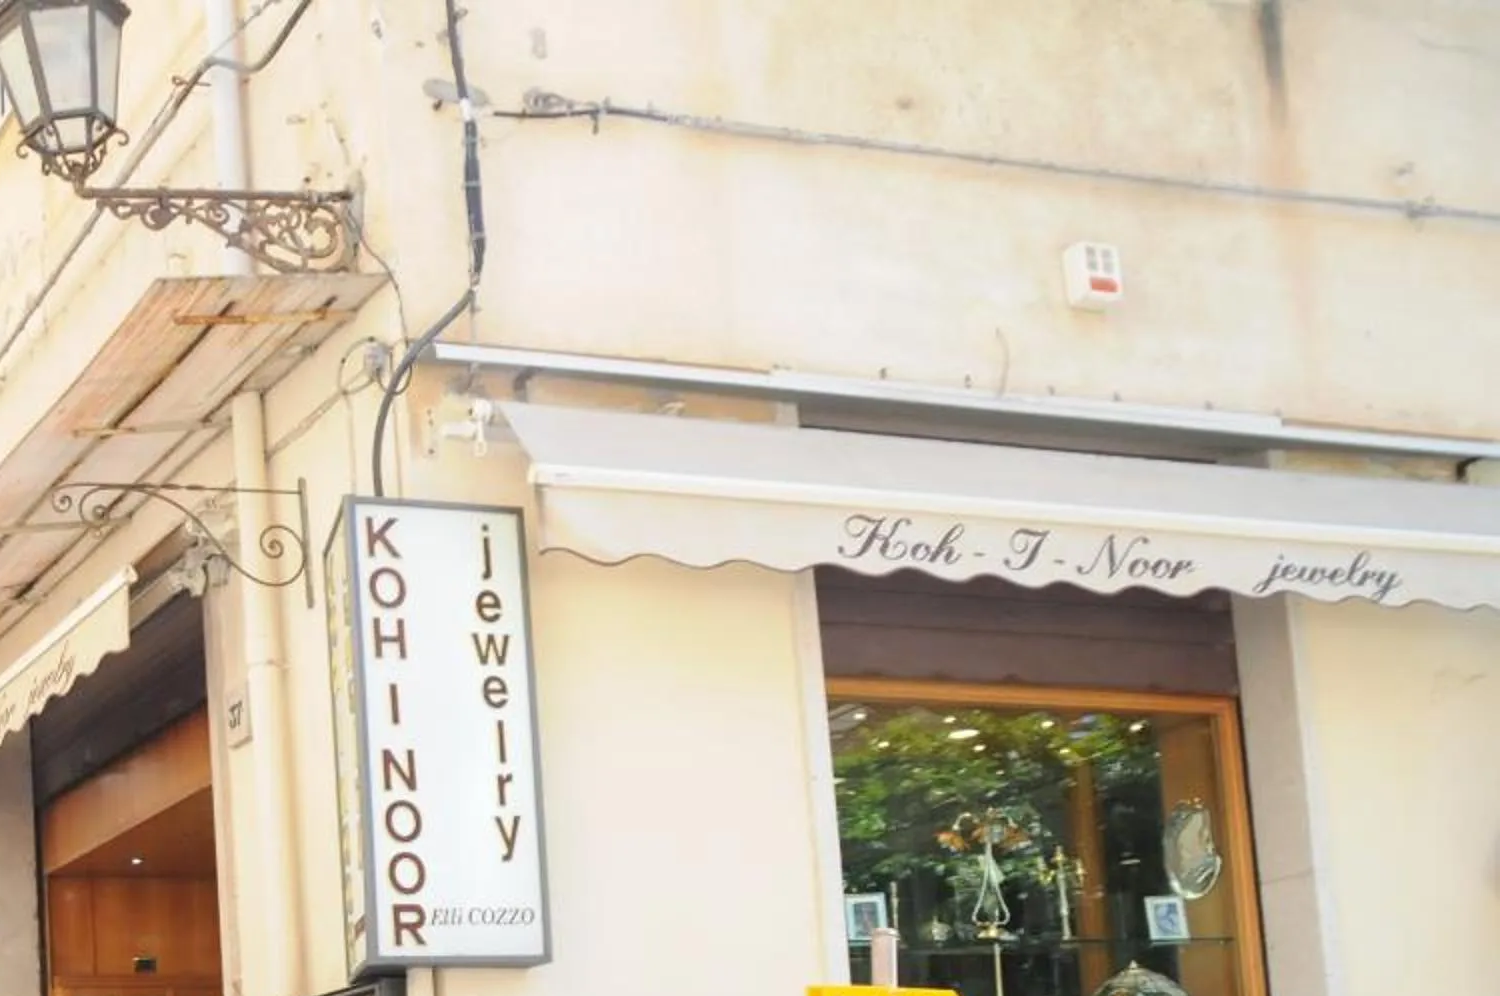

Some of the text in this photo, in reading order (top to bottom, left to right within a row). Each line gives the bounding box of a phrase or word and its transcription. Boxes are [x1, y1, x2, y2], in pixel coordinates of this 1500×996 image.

[837, 513, 965, 565] Koh
[1076, 533, 1197, 579] Noor
[1252, 550, 1403, 599] jewelry
[364, 516, 428, 947] KOH I NOOR
[471, 524, 522, 862] jewelry
[468, 906, 536, 927] COZZO
